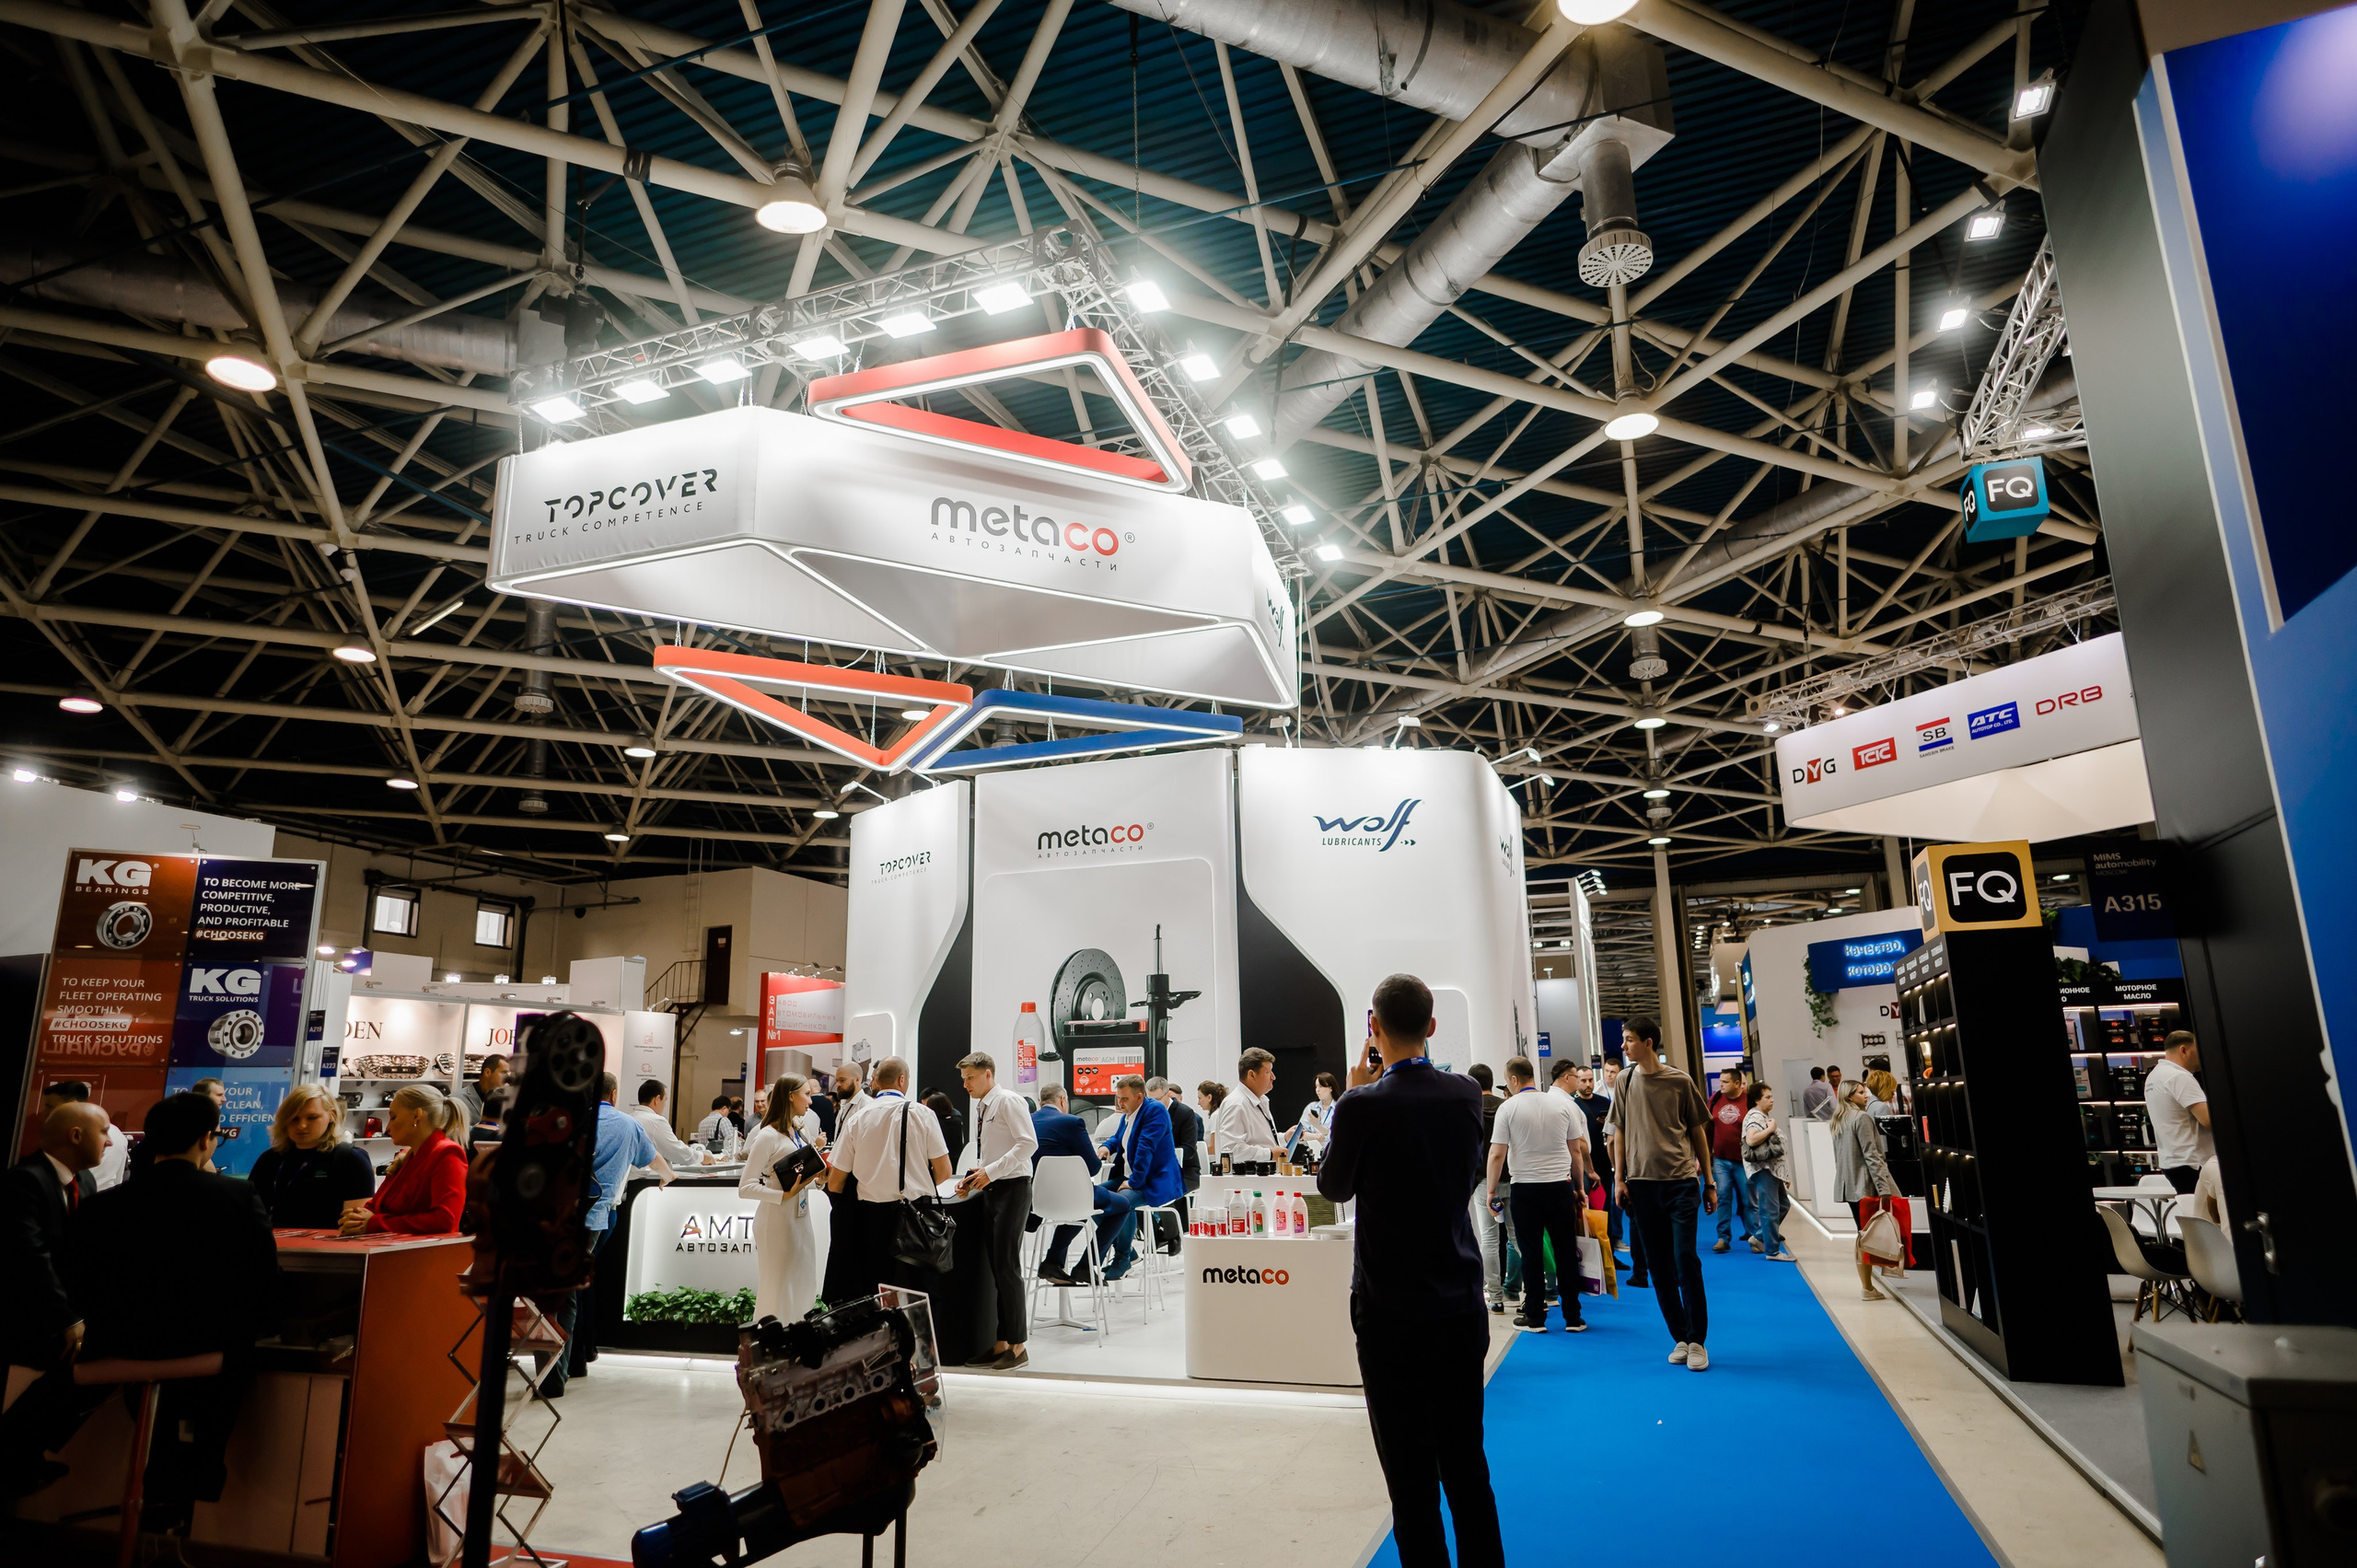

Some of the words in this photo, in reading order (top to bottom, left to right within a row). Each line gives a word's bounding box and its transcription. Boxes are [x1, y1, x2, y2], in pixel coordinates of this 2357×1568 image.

[543, 468, 718, 523] TOPCOVER
[1987, 476, 2034, 503] FQ
[1963, 490, 1976, 522] FQ
[515, 527, 569, 545] TRUCK
[582, 501, 703, 532] COMPETENCE
[931, 496, 1120, 556] metaco
[931, 532, 1118, 572] АВТОЗАПЧАСТИ
[2036, 685, 2103, 715] DRB
[1970, 707, 2014, 727] ATC
[1922, 726, 1946, 742] SB
[1793, 758, 1837, 784] DYG
[1313, 798, 1422, 853] wolf
[1038, 824, 1144, 850] metaco
[1322, 837, 1382, 846] LUBRICANTS
[1038, 845, 1144, 859] АВТОЗАПЧАСТИ
[2093, 853, 2121, 862] MIMS
[879, 851, 931, 875] TOPCOVER
[2095, 858, 2156, 869] automobility
[75, 859, 153, 888] KG
[75, 886, 149, 895] BEARINGS
[203, 877, 219, 887] TO
[222, 878, 267, 889] BECOME
[269, 881, 301, 891] MORE
[1949, 870, 2017, 906] FQ
[202, 890, 275, 903] COMPETITIVE,
[1918, 879, 1932, 916] FQ
[2104, 894, 2162, 913] A315
[200, 903, 271, 915] PRODUCTIVE,
[197, 916, 223, 925] AND
[225, 918, 290, 928] PROFITABLE
[195, 930, 264, 941] #CHOOSEKG
[1844, 940, 1905, 957] Качество,
[62, 977, 78, 986] TO
[81, 978, 110, 987] KEEP
[112, 979, 145, 988] YOUR
[189, 968, 262, 995] KG
[2115, 983, 2157, 993] МОТОРНОЕ
[59, 992, 93, 1000] FLEET
[96, 992, 162, 1002] OPERATING
[57, 1005, 124, 1015] SMOOTHLY
[53, 1020, 127, 1029] #CHOOSEKG
[52, 1034, 92, 1043] TRUCK
[95, 1035, 163, 1044] SOLUTIONS
[226, 1100, 263, 1109] CLEAN,
[676, 1242, 758, 1253] АВТОЗАП
[1202, 1265, 1289, 1285] metaco
